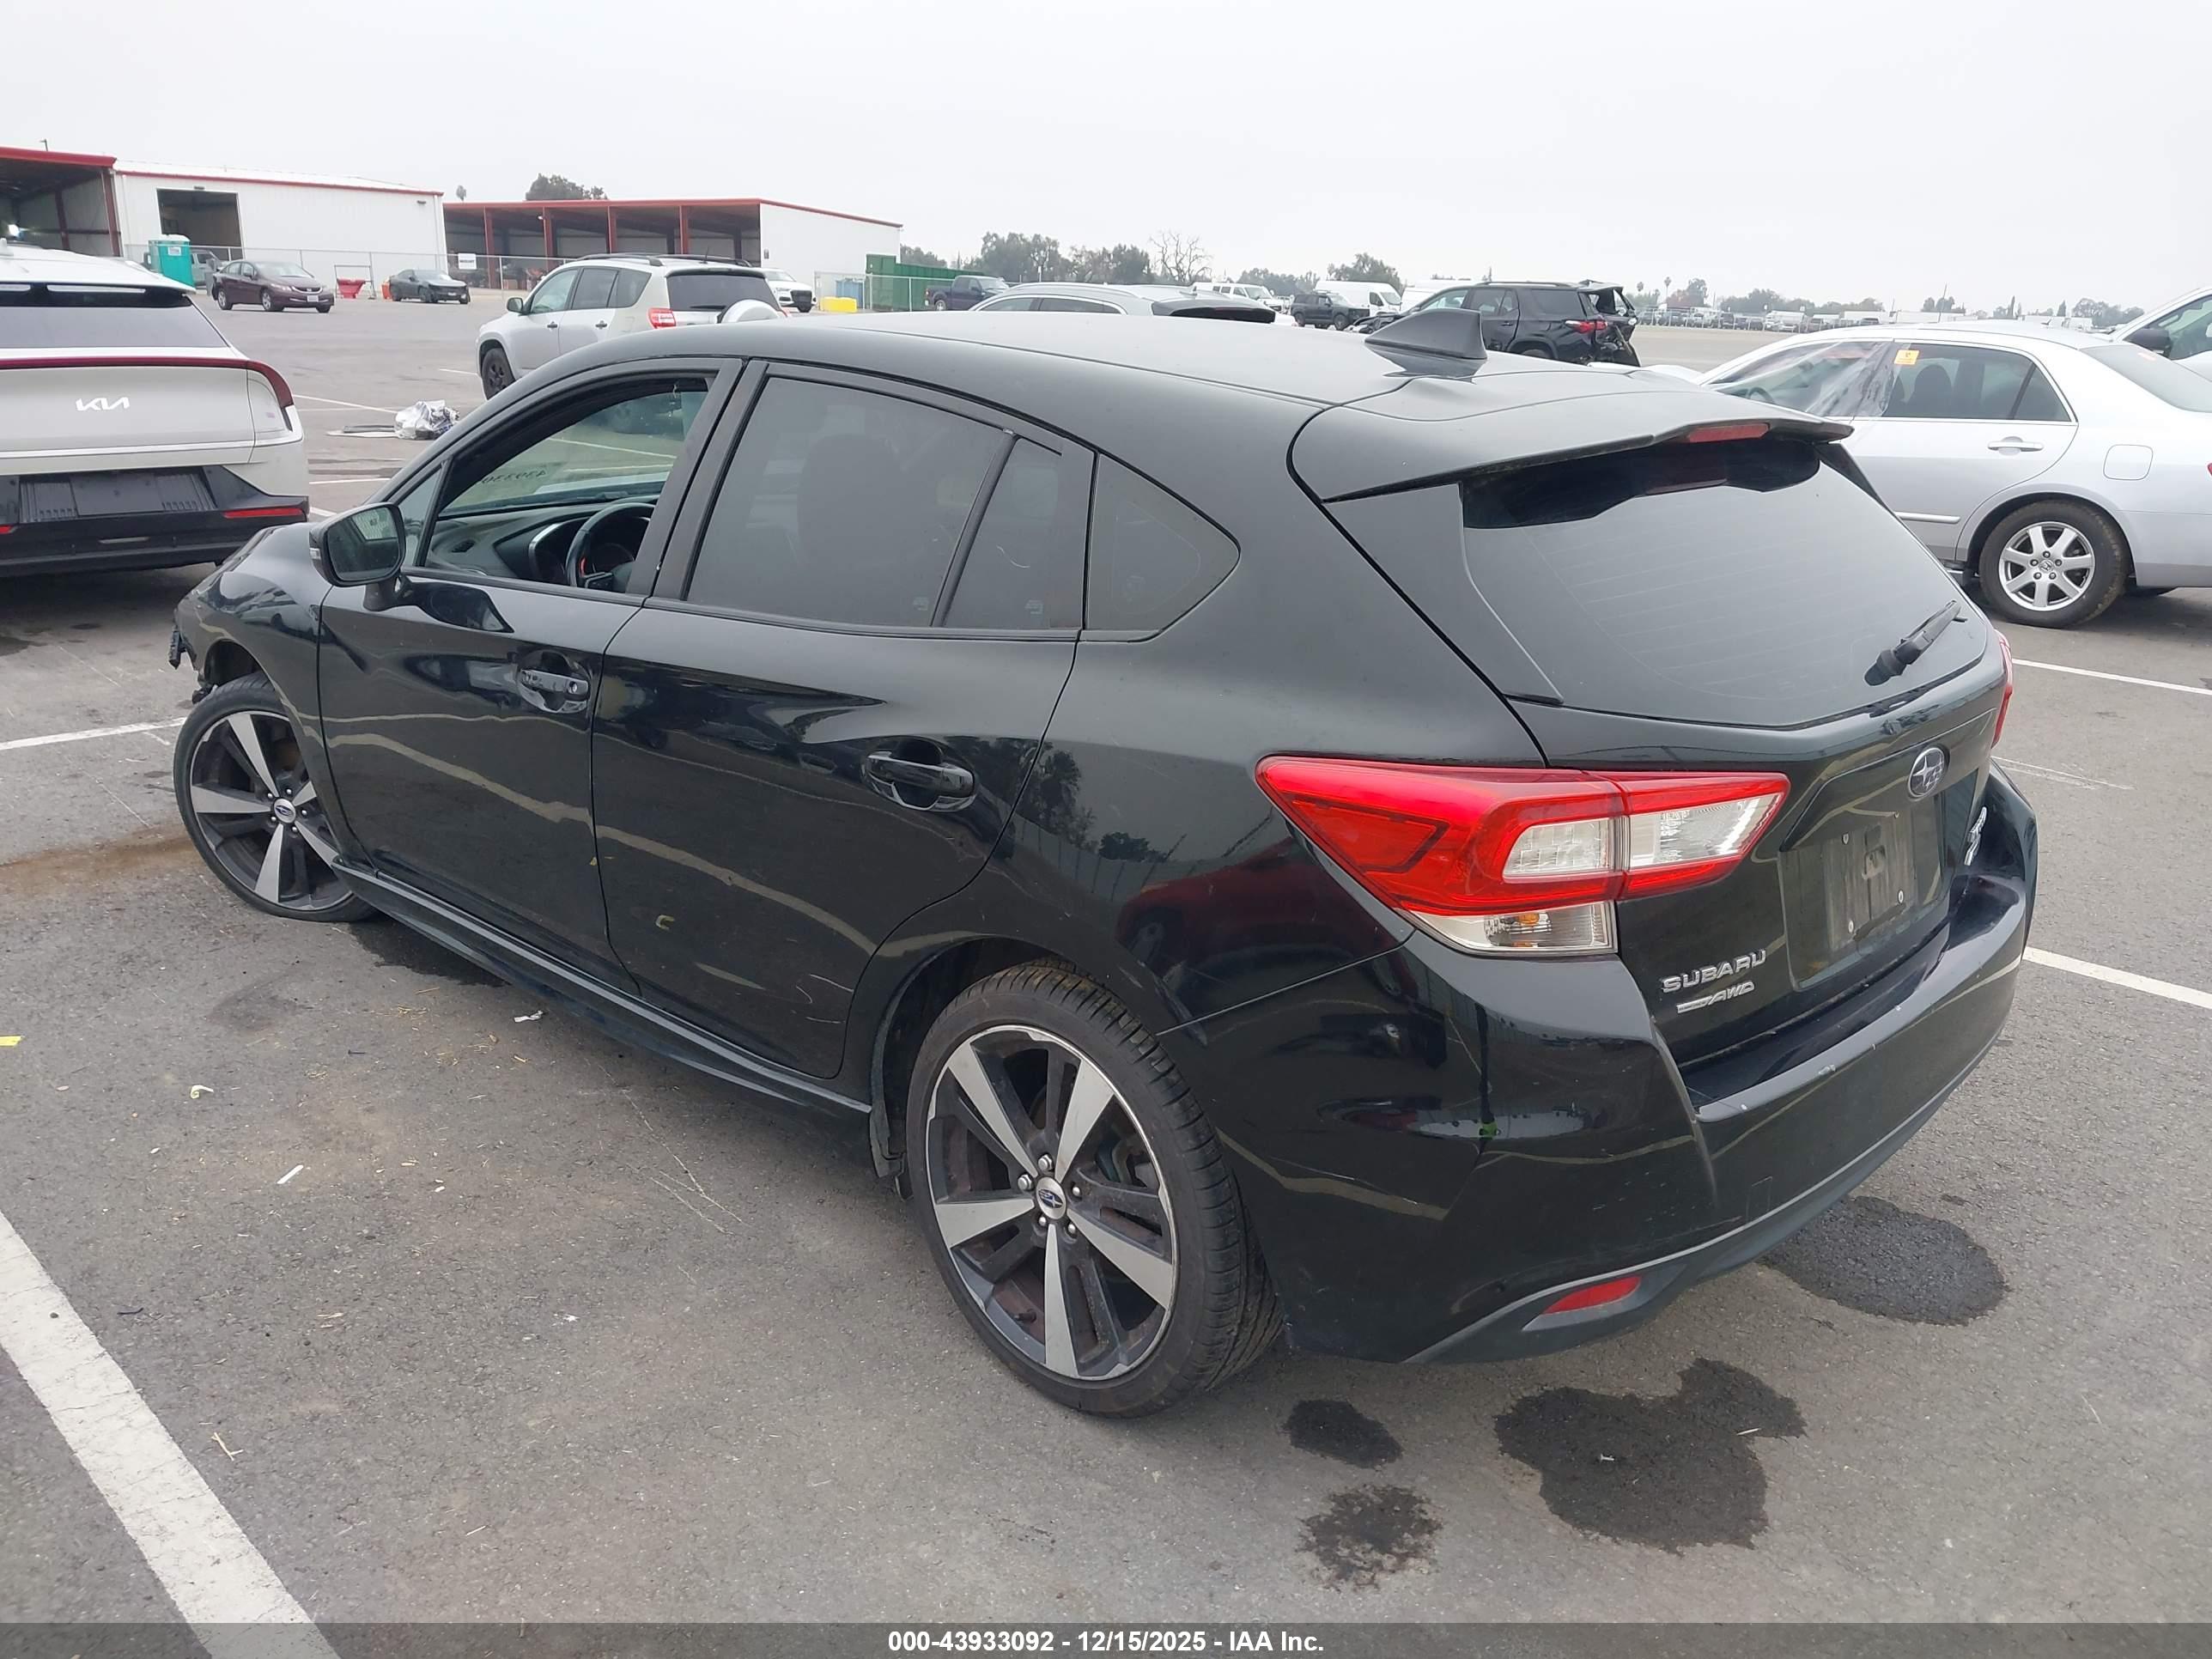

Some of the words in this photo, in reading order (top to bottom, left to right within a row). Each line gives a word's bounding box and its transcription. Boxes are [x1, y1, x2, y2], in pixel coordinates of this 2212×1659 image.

[75, 396, 131, 411] KIA
[1661, 949, 1766, 994] SUBARU
[1707, 980, 1755, 1006] AWD
